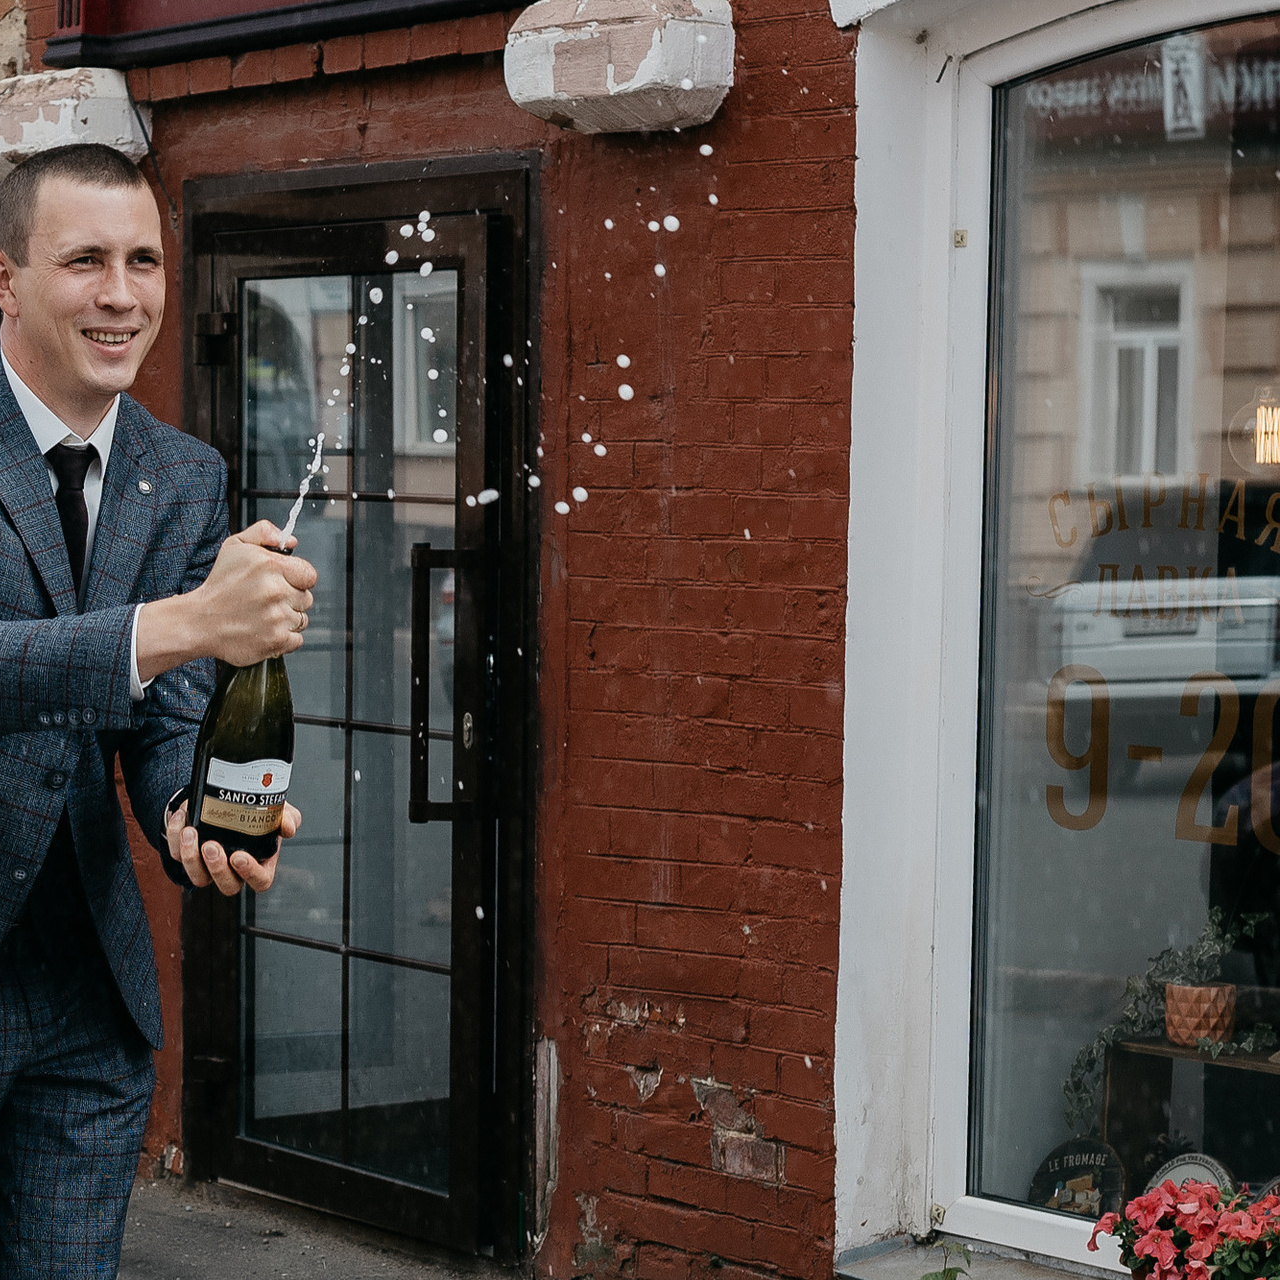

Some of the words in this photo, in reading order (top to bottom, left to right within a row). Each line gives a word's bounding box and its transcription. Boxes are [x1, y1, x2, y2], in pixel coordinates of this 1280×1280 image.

[1048, 472, 1280, 554] СЫРНАЯ
[1092, 564, 1246, 625] ЛАВКА
[219, 789, 257, 805] SANTO
[239, 814, 277, 823] BIANCO
[1048, 1159, 1060, 1173] LE
[1063, 1153, 1108, 1168] FROMAGE
